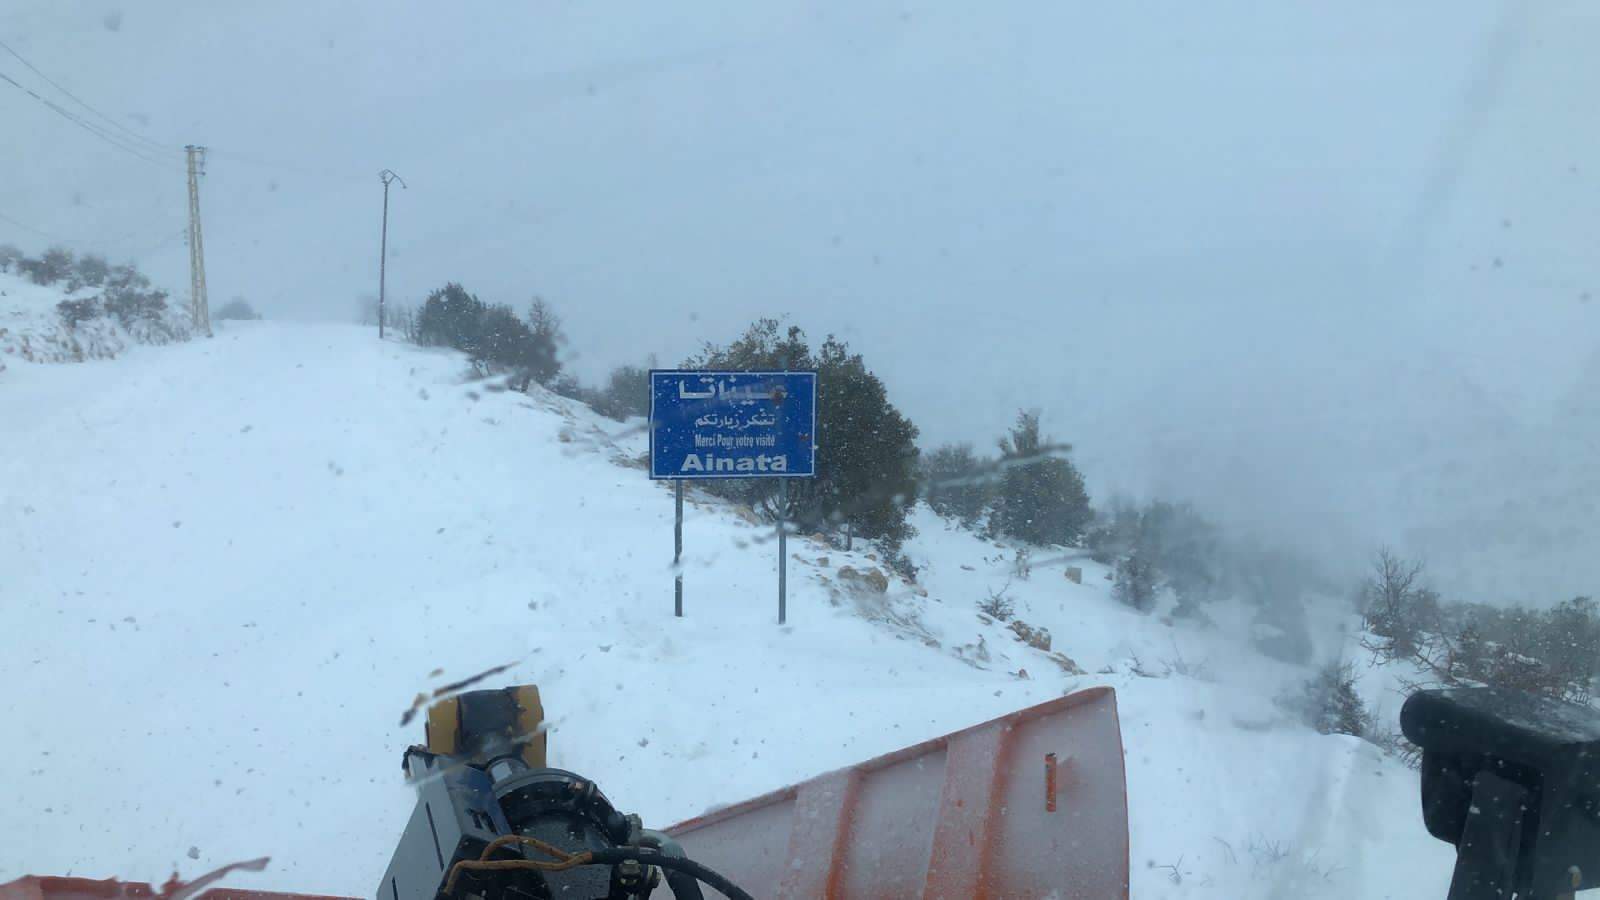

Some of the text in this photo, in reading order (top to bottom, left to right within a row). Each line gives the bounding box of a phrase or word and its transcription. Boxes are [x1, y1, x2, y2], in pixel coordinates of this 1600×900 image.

[695, 413, 740, 429] زيارتكم
[695, 434, 716, 447] Merci
[717, 434, 734, 447] Pour
[735, 434, 754, 448] votre
[680, 453, 788, 472] Ainata
